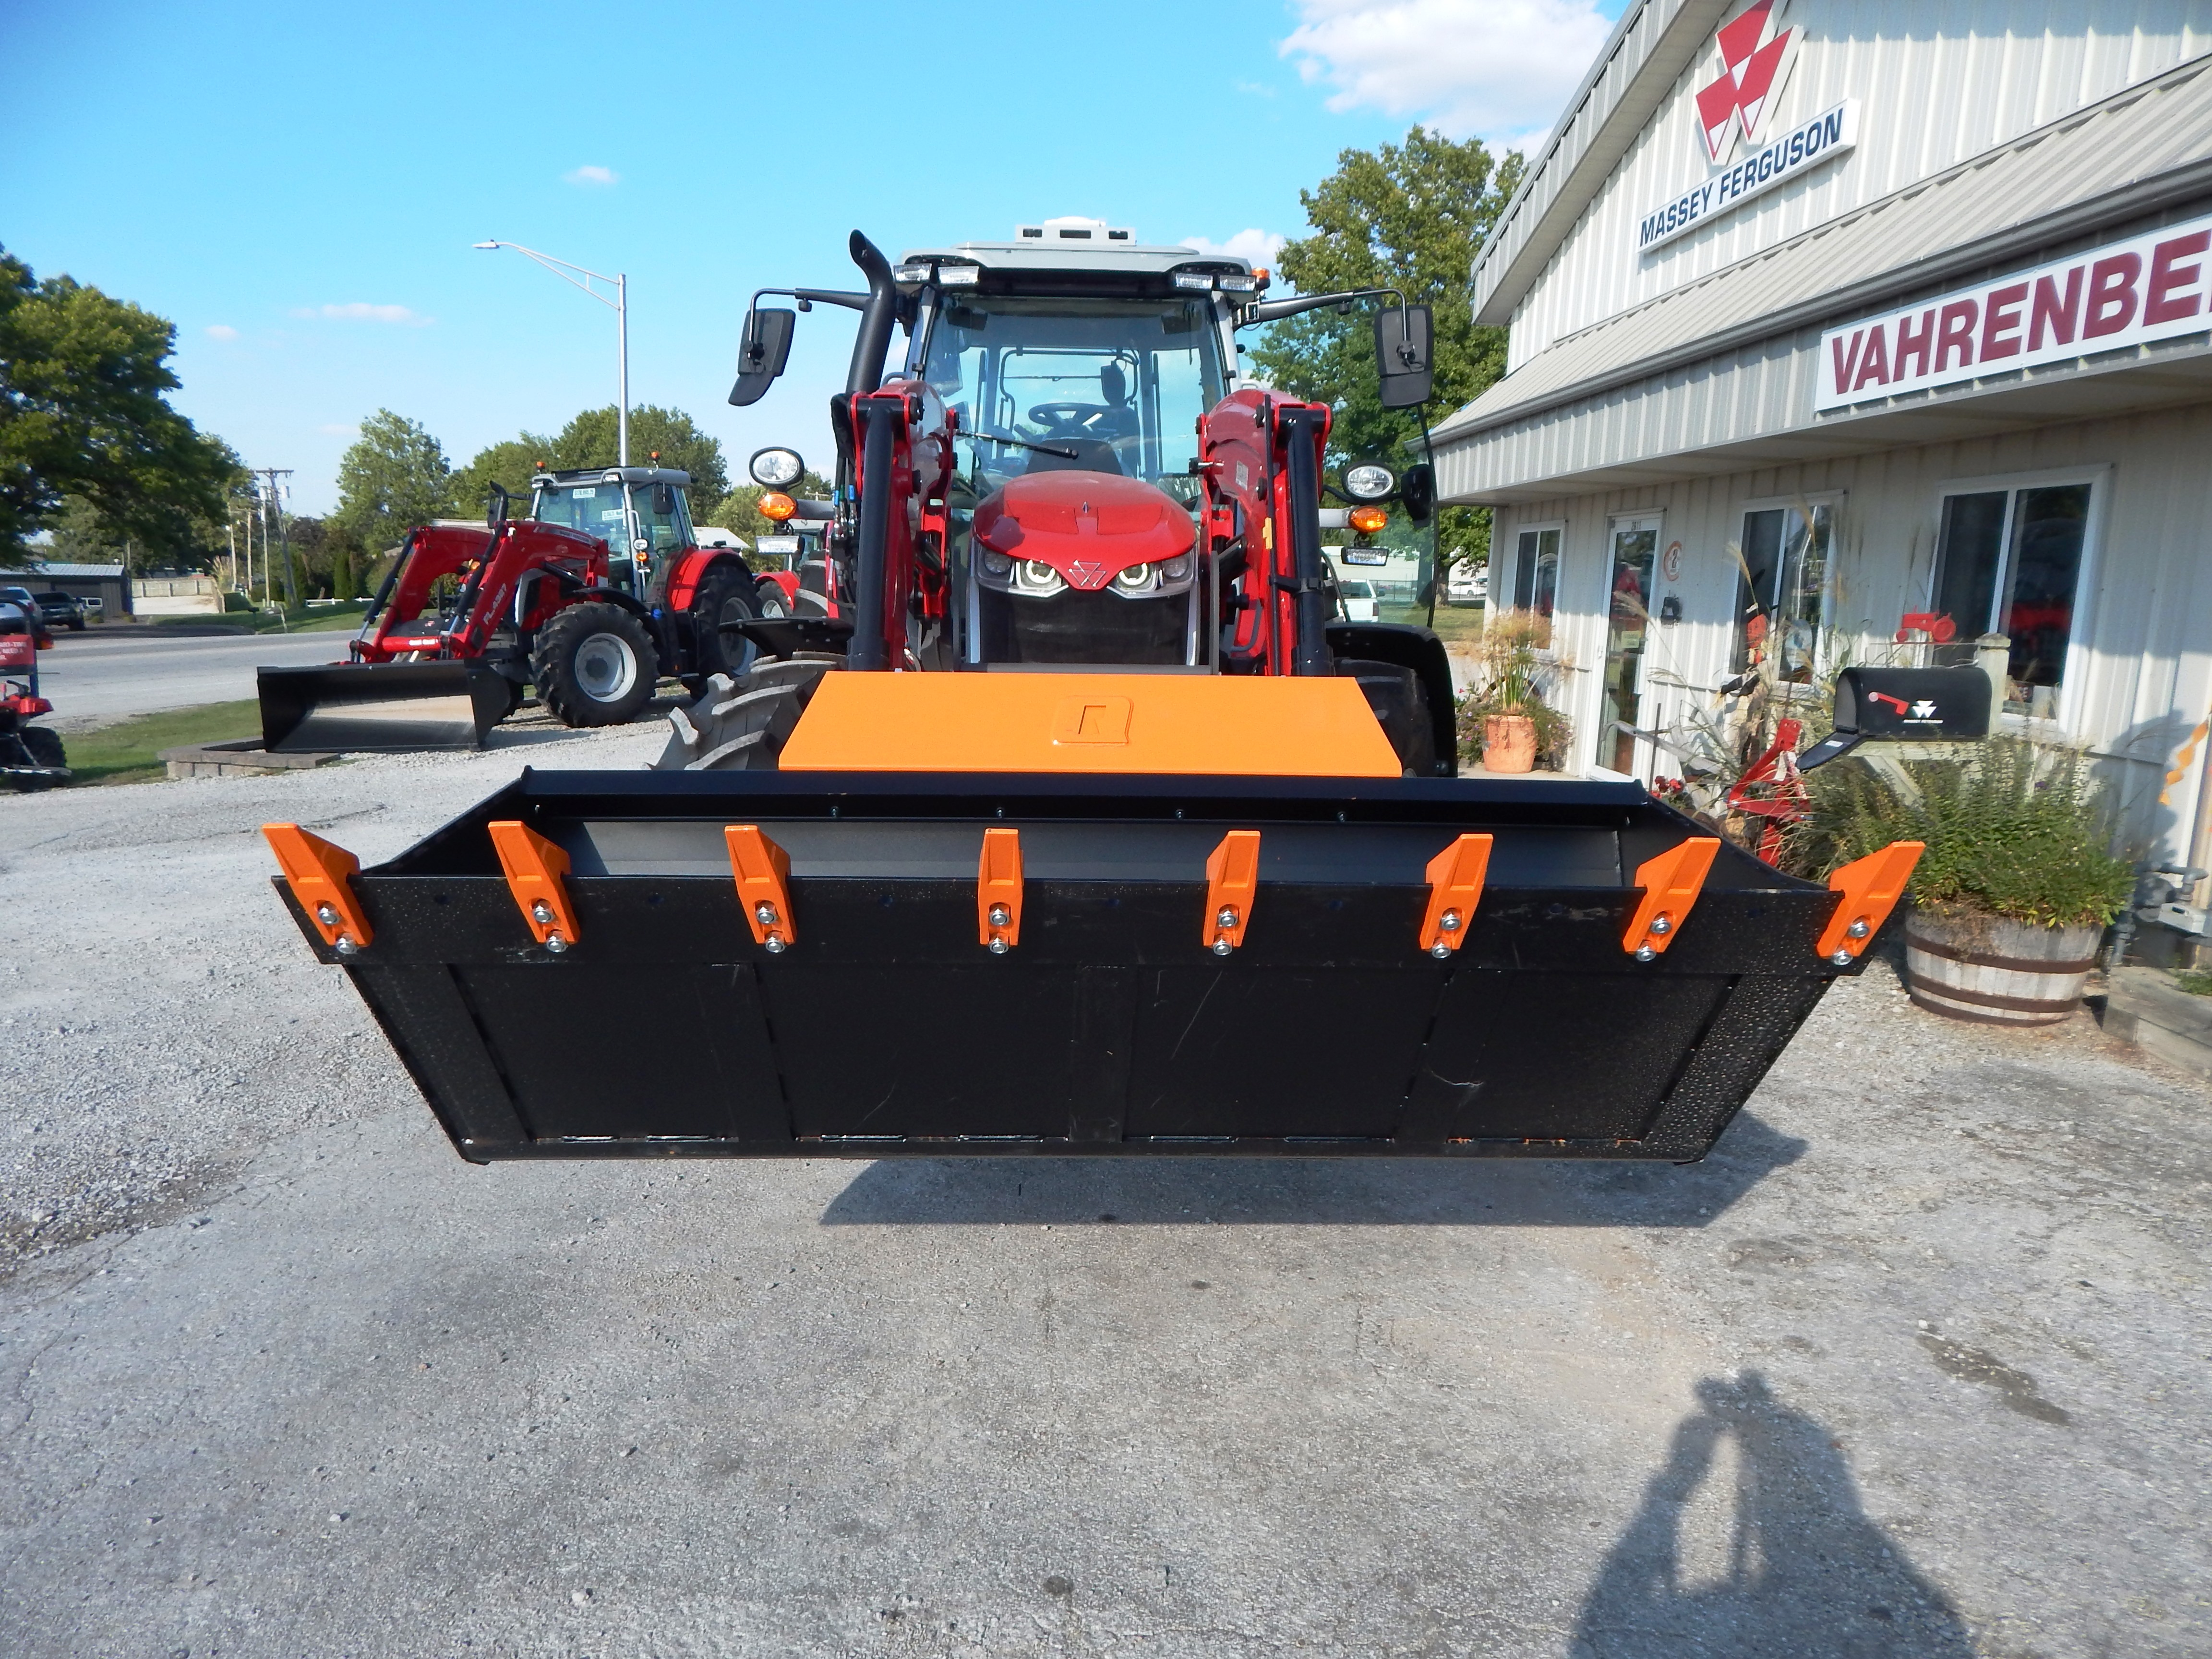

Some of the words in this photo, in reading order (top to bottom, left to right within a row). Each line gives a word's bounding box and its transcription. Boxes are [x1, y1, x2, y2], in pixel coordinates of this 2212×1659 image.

[1639, 182, 1713, 247] MASSEY
[1719, 108, 1843, 204] FERGUSON
[1832, 228, 2212, 395] VAHRENBE
